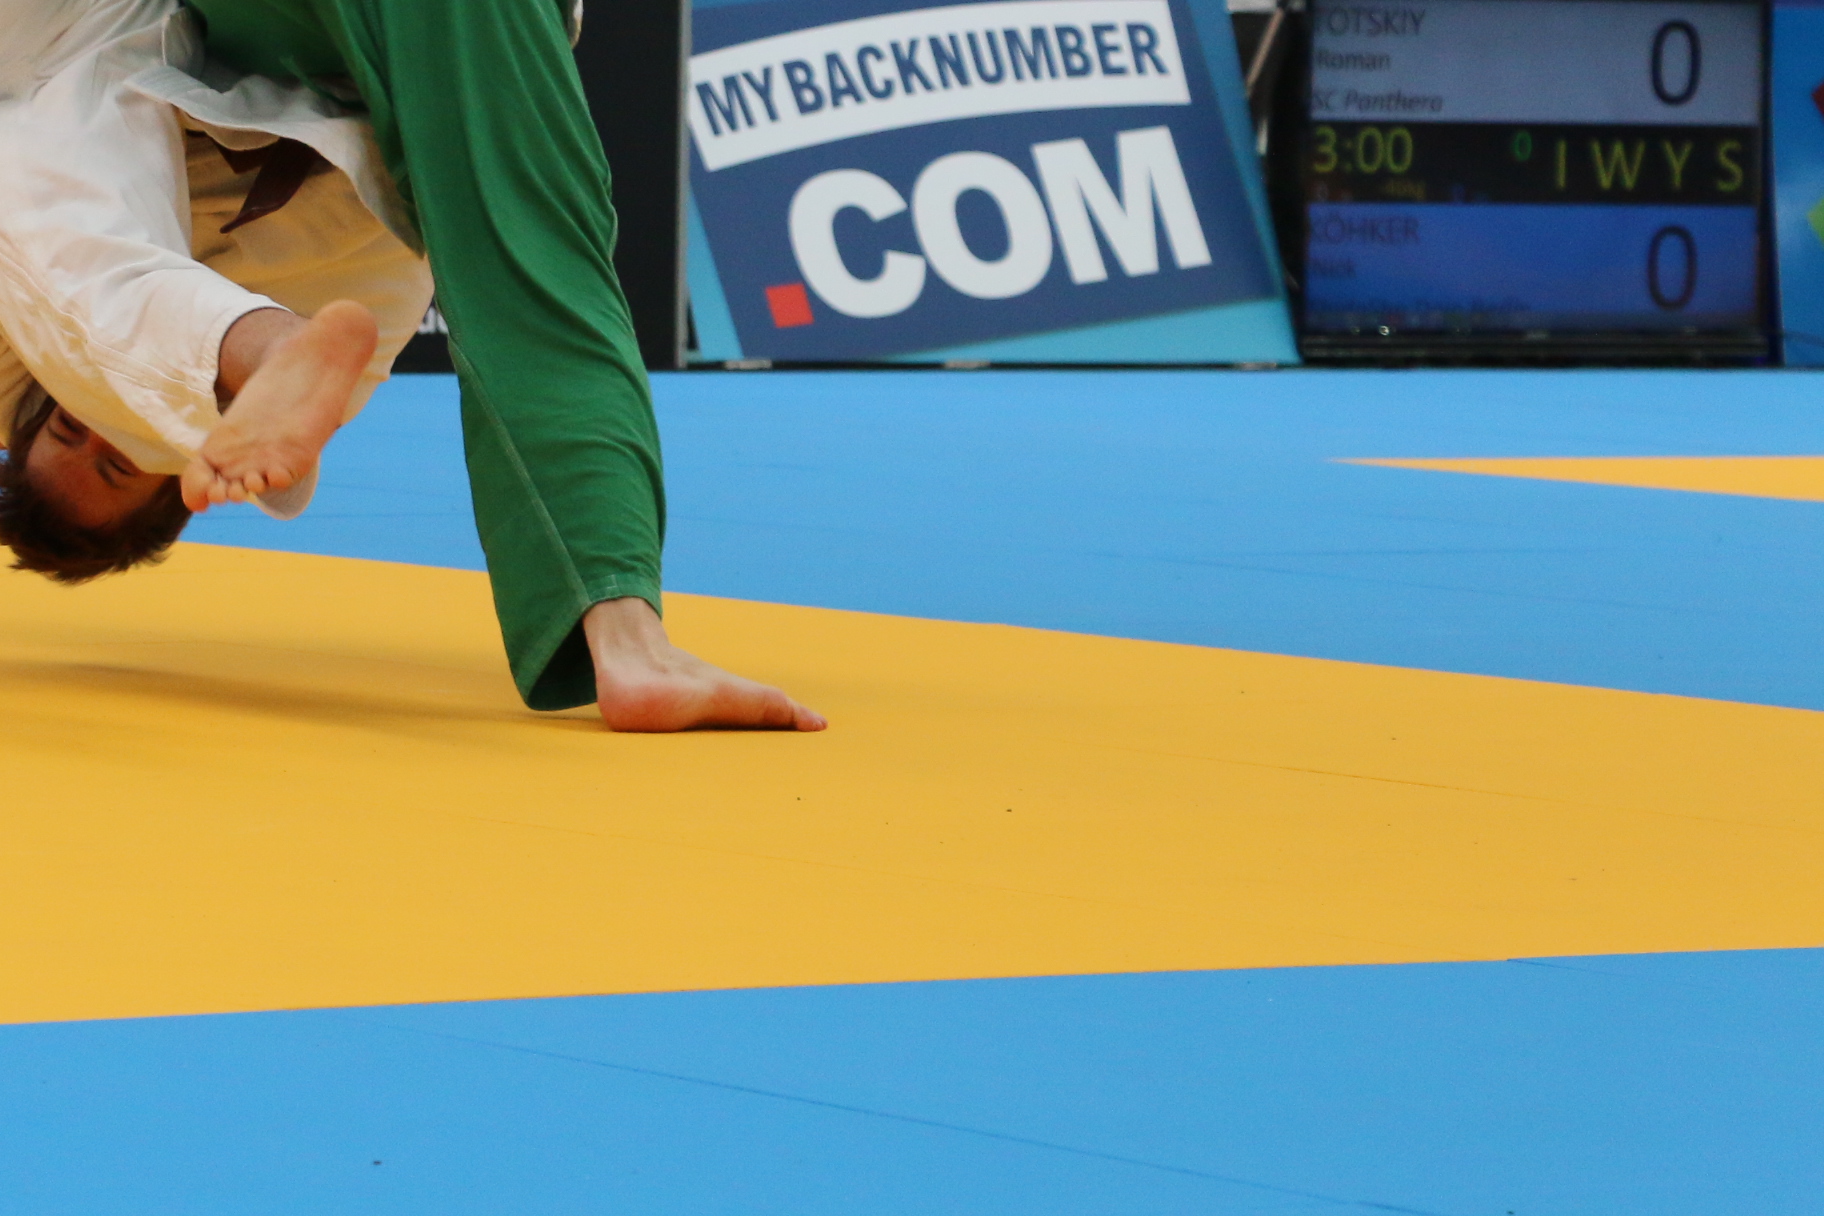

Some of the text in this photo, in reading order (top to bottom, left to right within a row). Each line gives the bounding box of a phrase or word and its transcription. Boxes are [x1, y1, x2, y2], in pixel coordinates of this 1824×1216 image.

[1650, 19, 1702, 106] 0
[1312, 126, 1414, 173] 3:00
[1590, 139, 1646, 190] W
[1662, 140, 1693, 190] Y
[1716, 140, 1744, 192] S
[1647, 225, 1698, 311] 0
